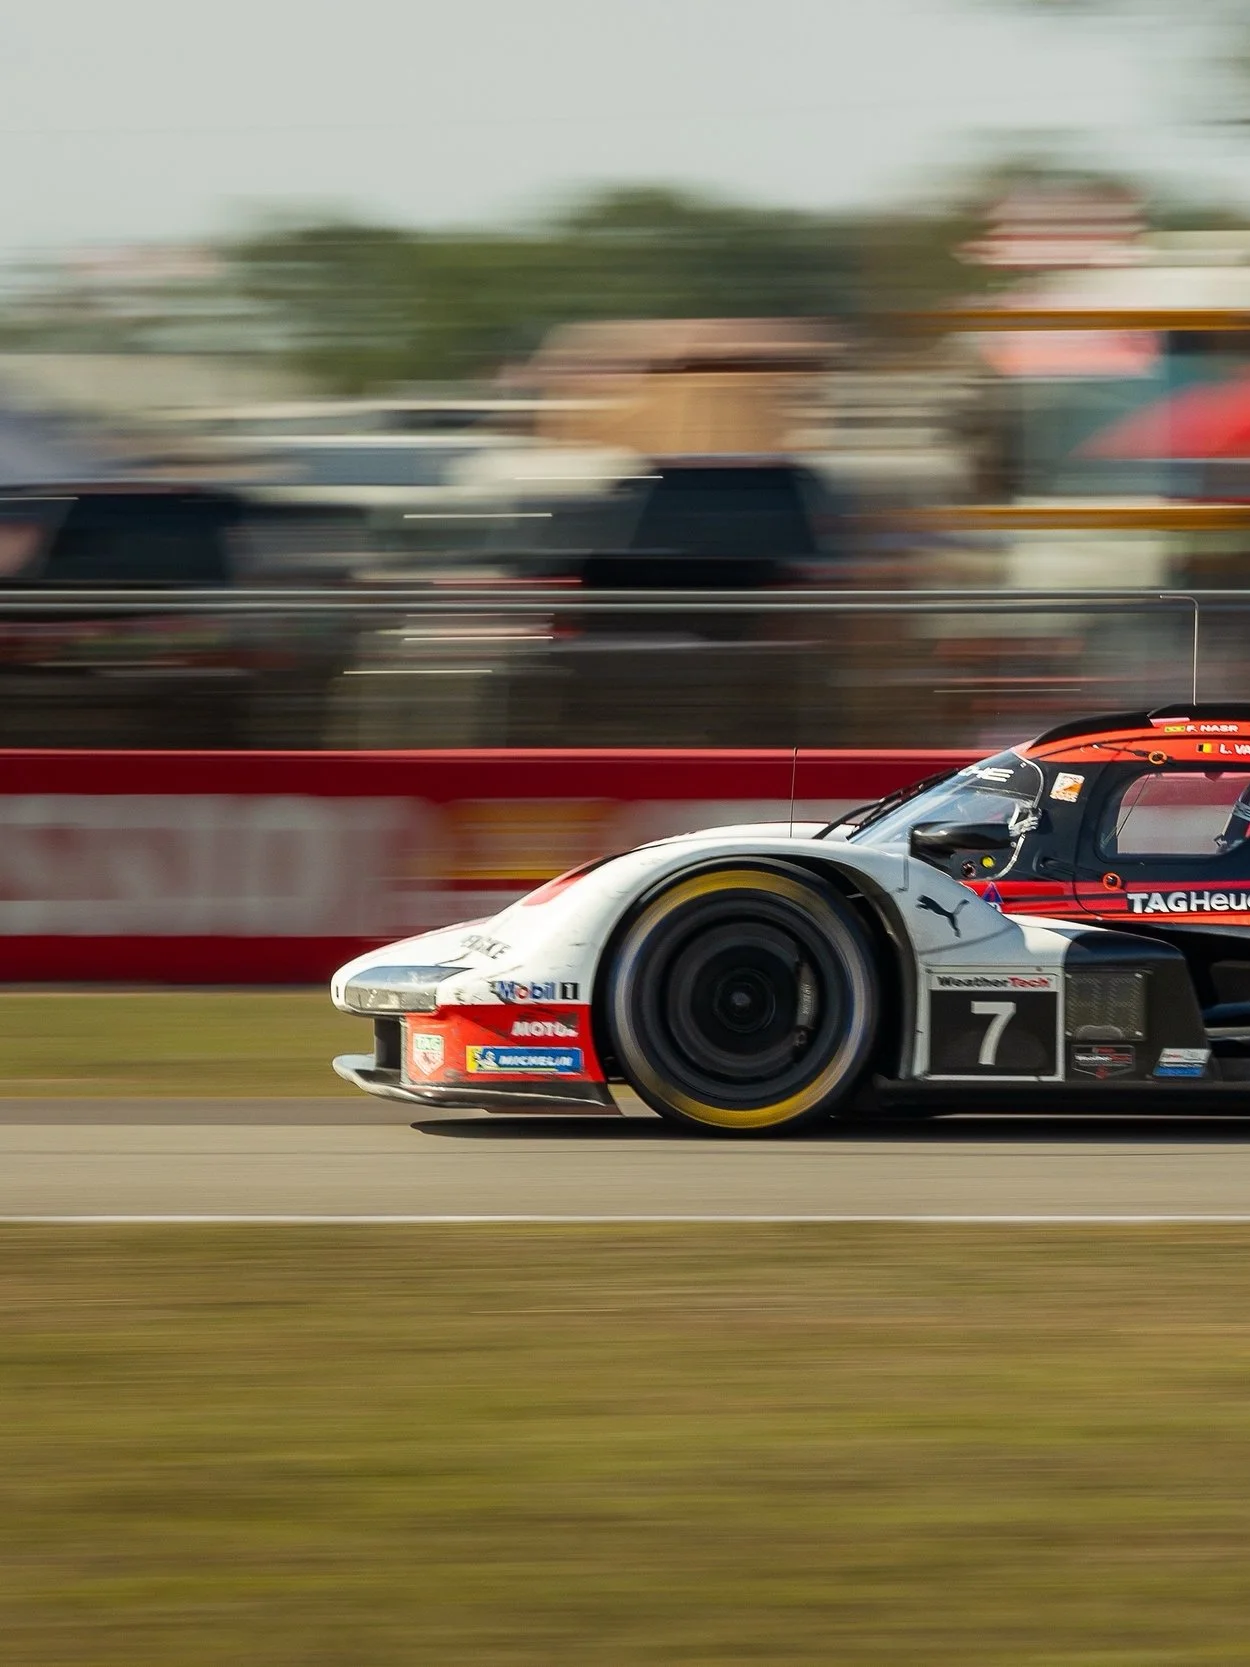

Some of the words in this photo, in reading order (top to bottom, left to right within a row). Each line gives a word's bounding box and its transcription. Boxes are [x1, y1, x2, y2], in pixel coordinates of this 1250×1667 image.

[1186, 725, 1198, 733] F.
[1200, 724, 1239, 733] NASR
[1219, 743, 1232, 755] L.
[937, 976, 1050, 988] WeatherTech
[496, 980, 555, 1001] Mobil
[971, 1001, 1017, 1066] 7
[498, 1055, 574, 1067] MICHELIN
